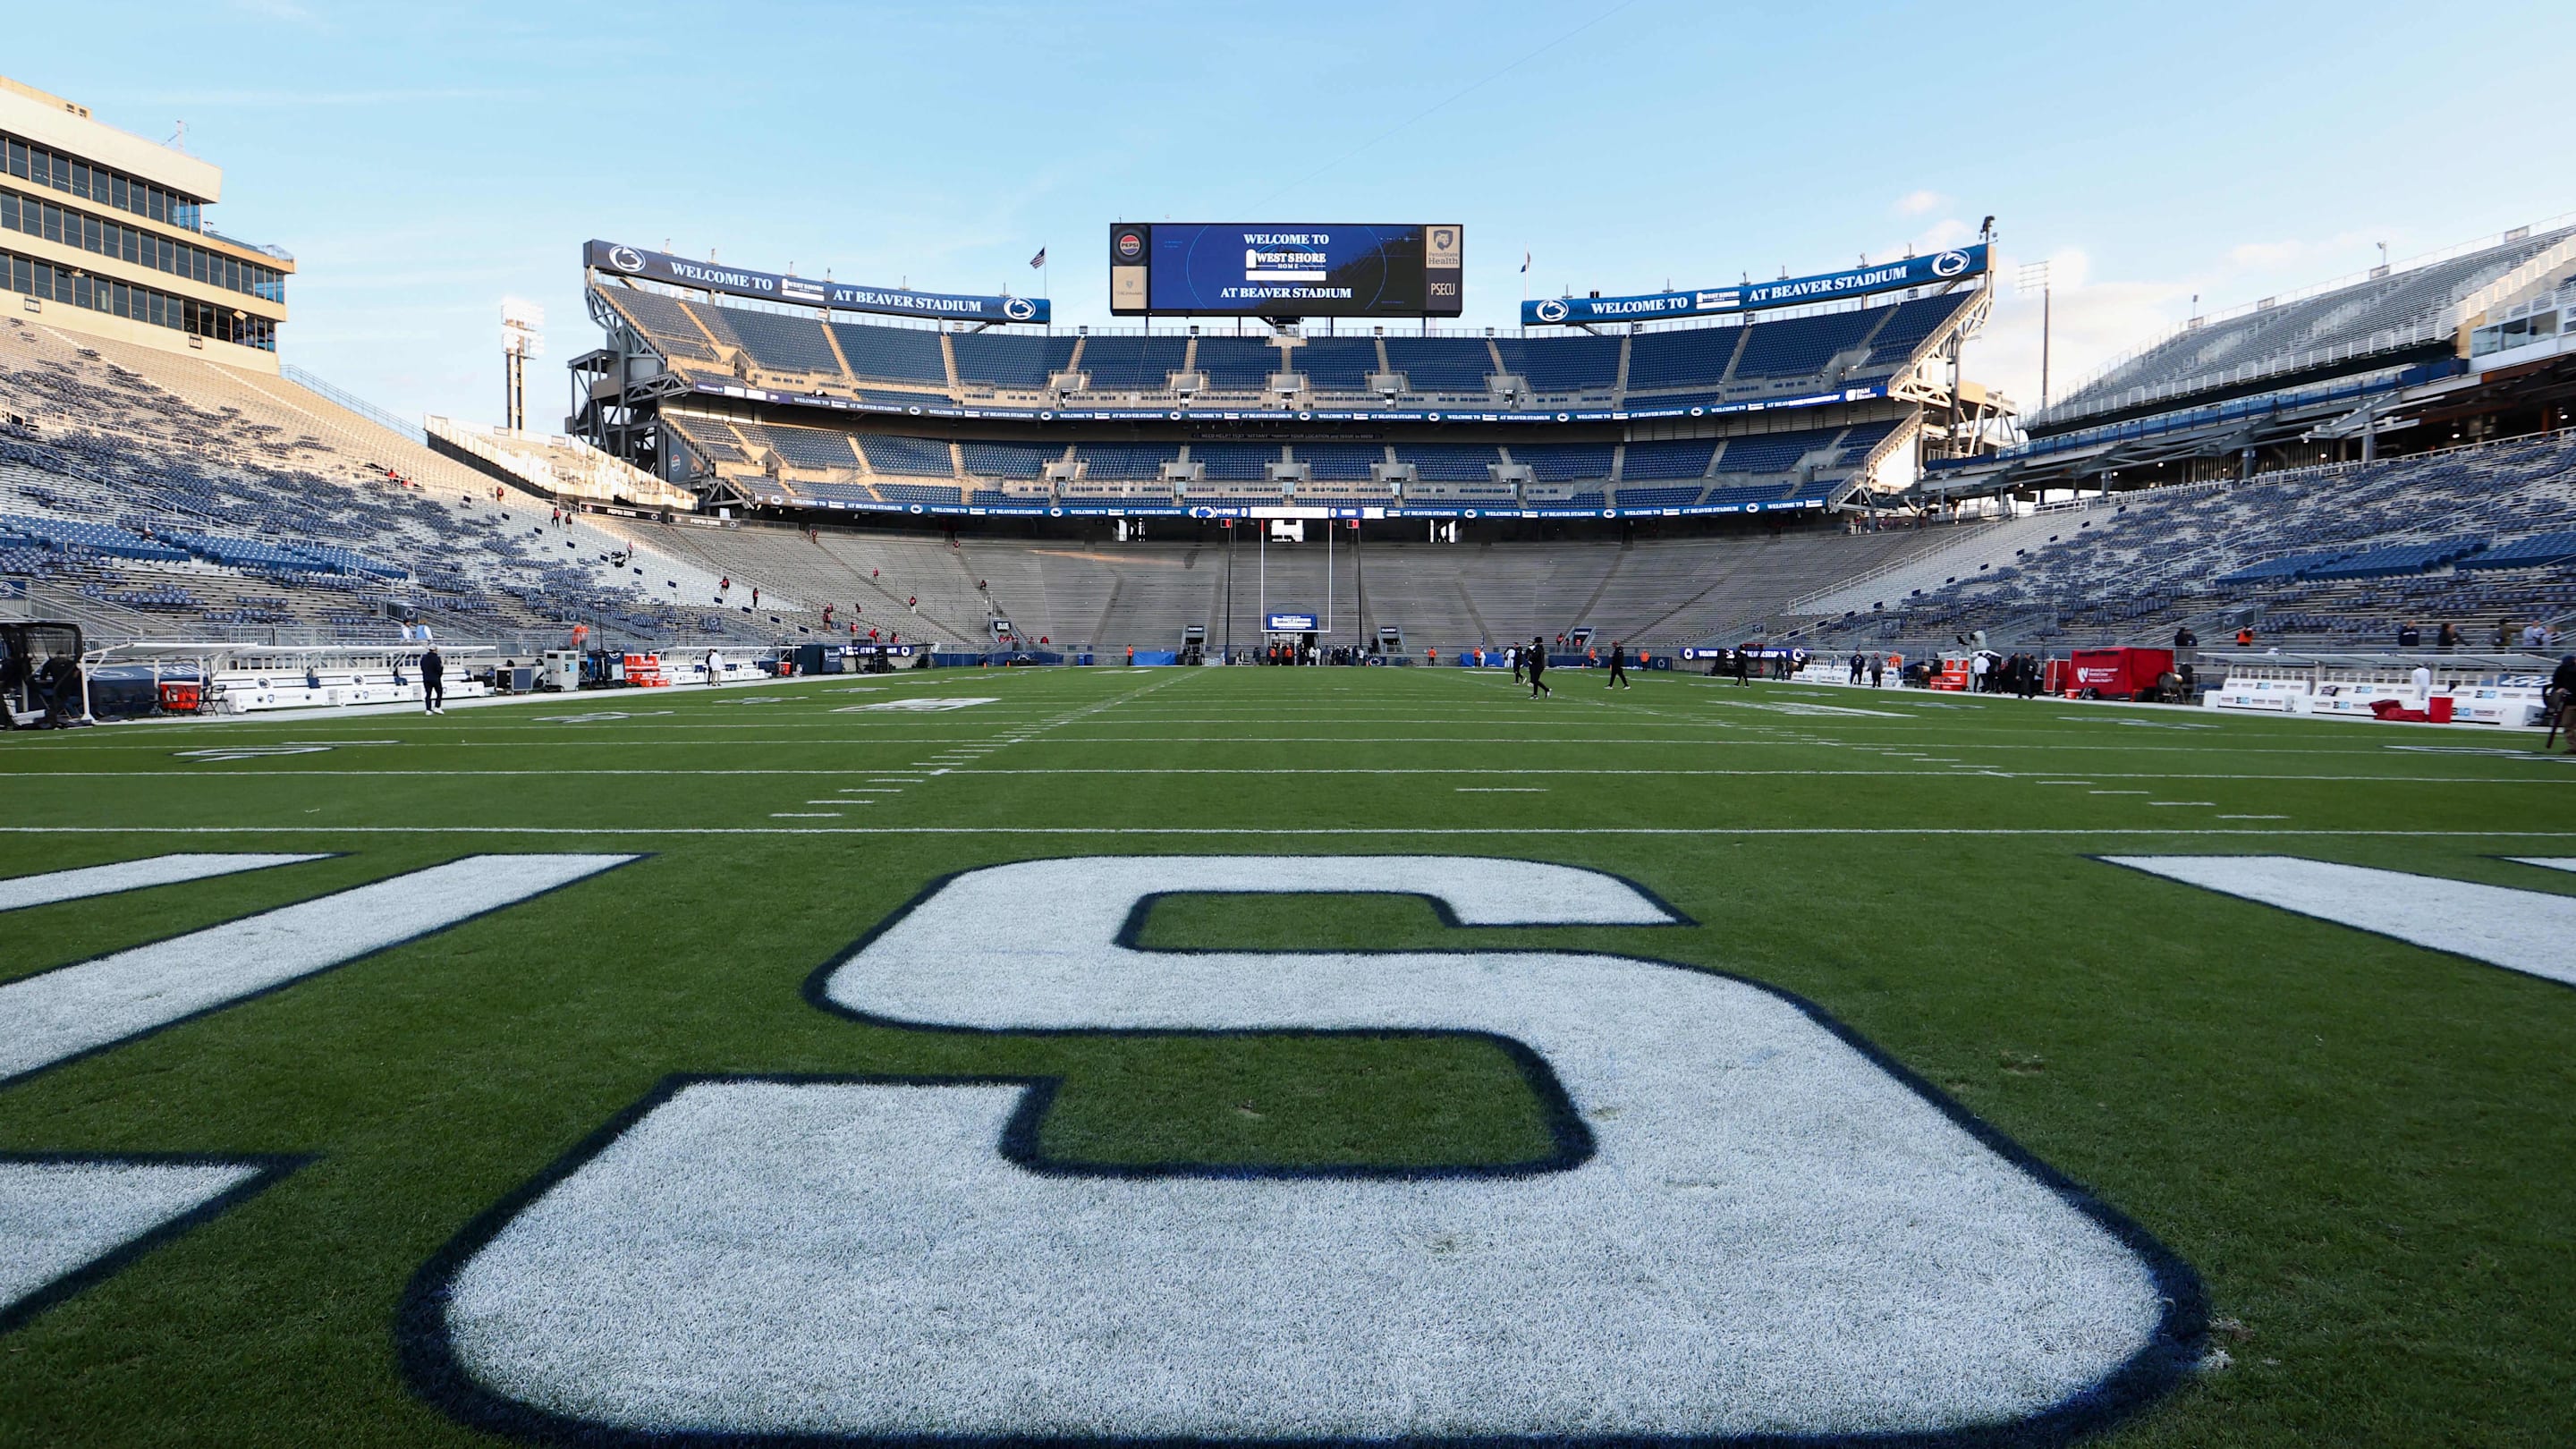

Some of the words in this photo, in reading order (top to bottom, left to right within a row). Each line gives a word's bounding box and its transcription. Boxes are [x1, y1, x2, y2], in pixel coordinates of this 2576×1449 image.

[1243, 233, 1309, 244] WELCOME
[1311, 233, 1329, 244] TO
[1256, 252, 1287, 263] WEST
[1288, 252, 1326, 263] SHORE
[1428, 257, 1458, 265] Health
[670, 261, 749, 287] WELCOME
[751, 276, 774, 291] TO
[833, 289, 853, 301] AT
[855, 291, 914, 308] BEAVER
[916, 297, 982, 312] STADIUM
[1430, 283, 1455, 296] PSECU
[1591, 299, 1665, 314] WELCOME
[1667, 297, 1688, 309] TO
[1749, 288, 1768, 302] AT
[1771, 279, 1833, 299] BEAVER
[1835, 266, 1907, 290] STADIUM
[1220, 287, 1238, 298] AT
[1240, 287, 1292, 298] BEAVER
[1292, 287, 1352, 299] STADIUM
[1710, 405, 1738, 413] WELCOME
[1241, 507, 1248, 517] 0
[1330, 507, 1337, 517] 0
[402, 852, 2209, 1449] S
